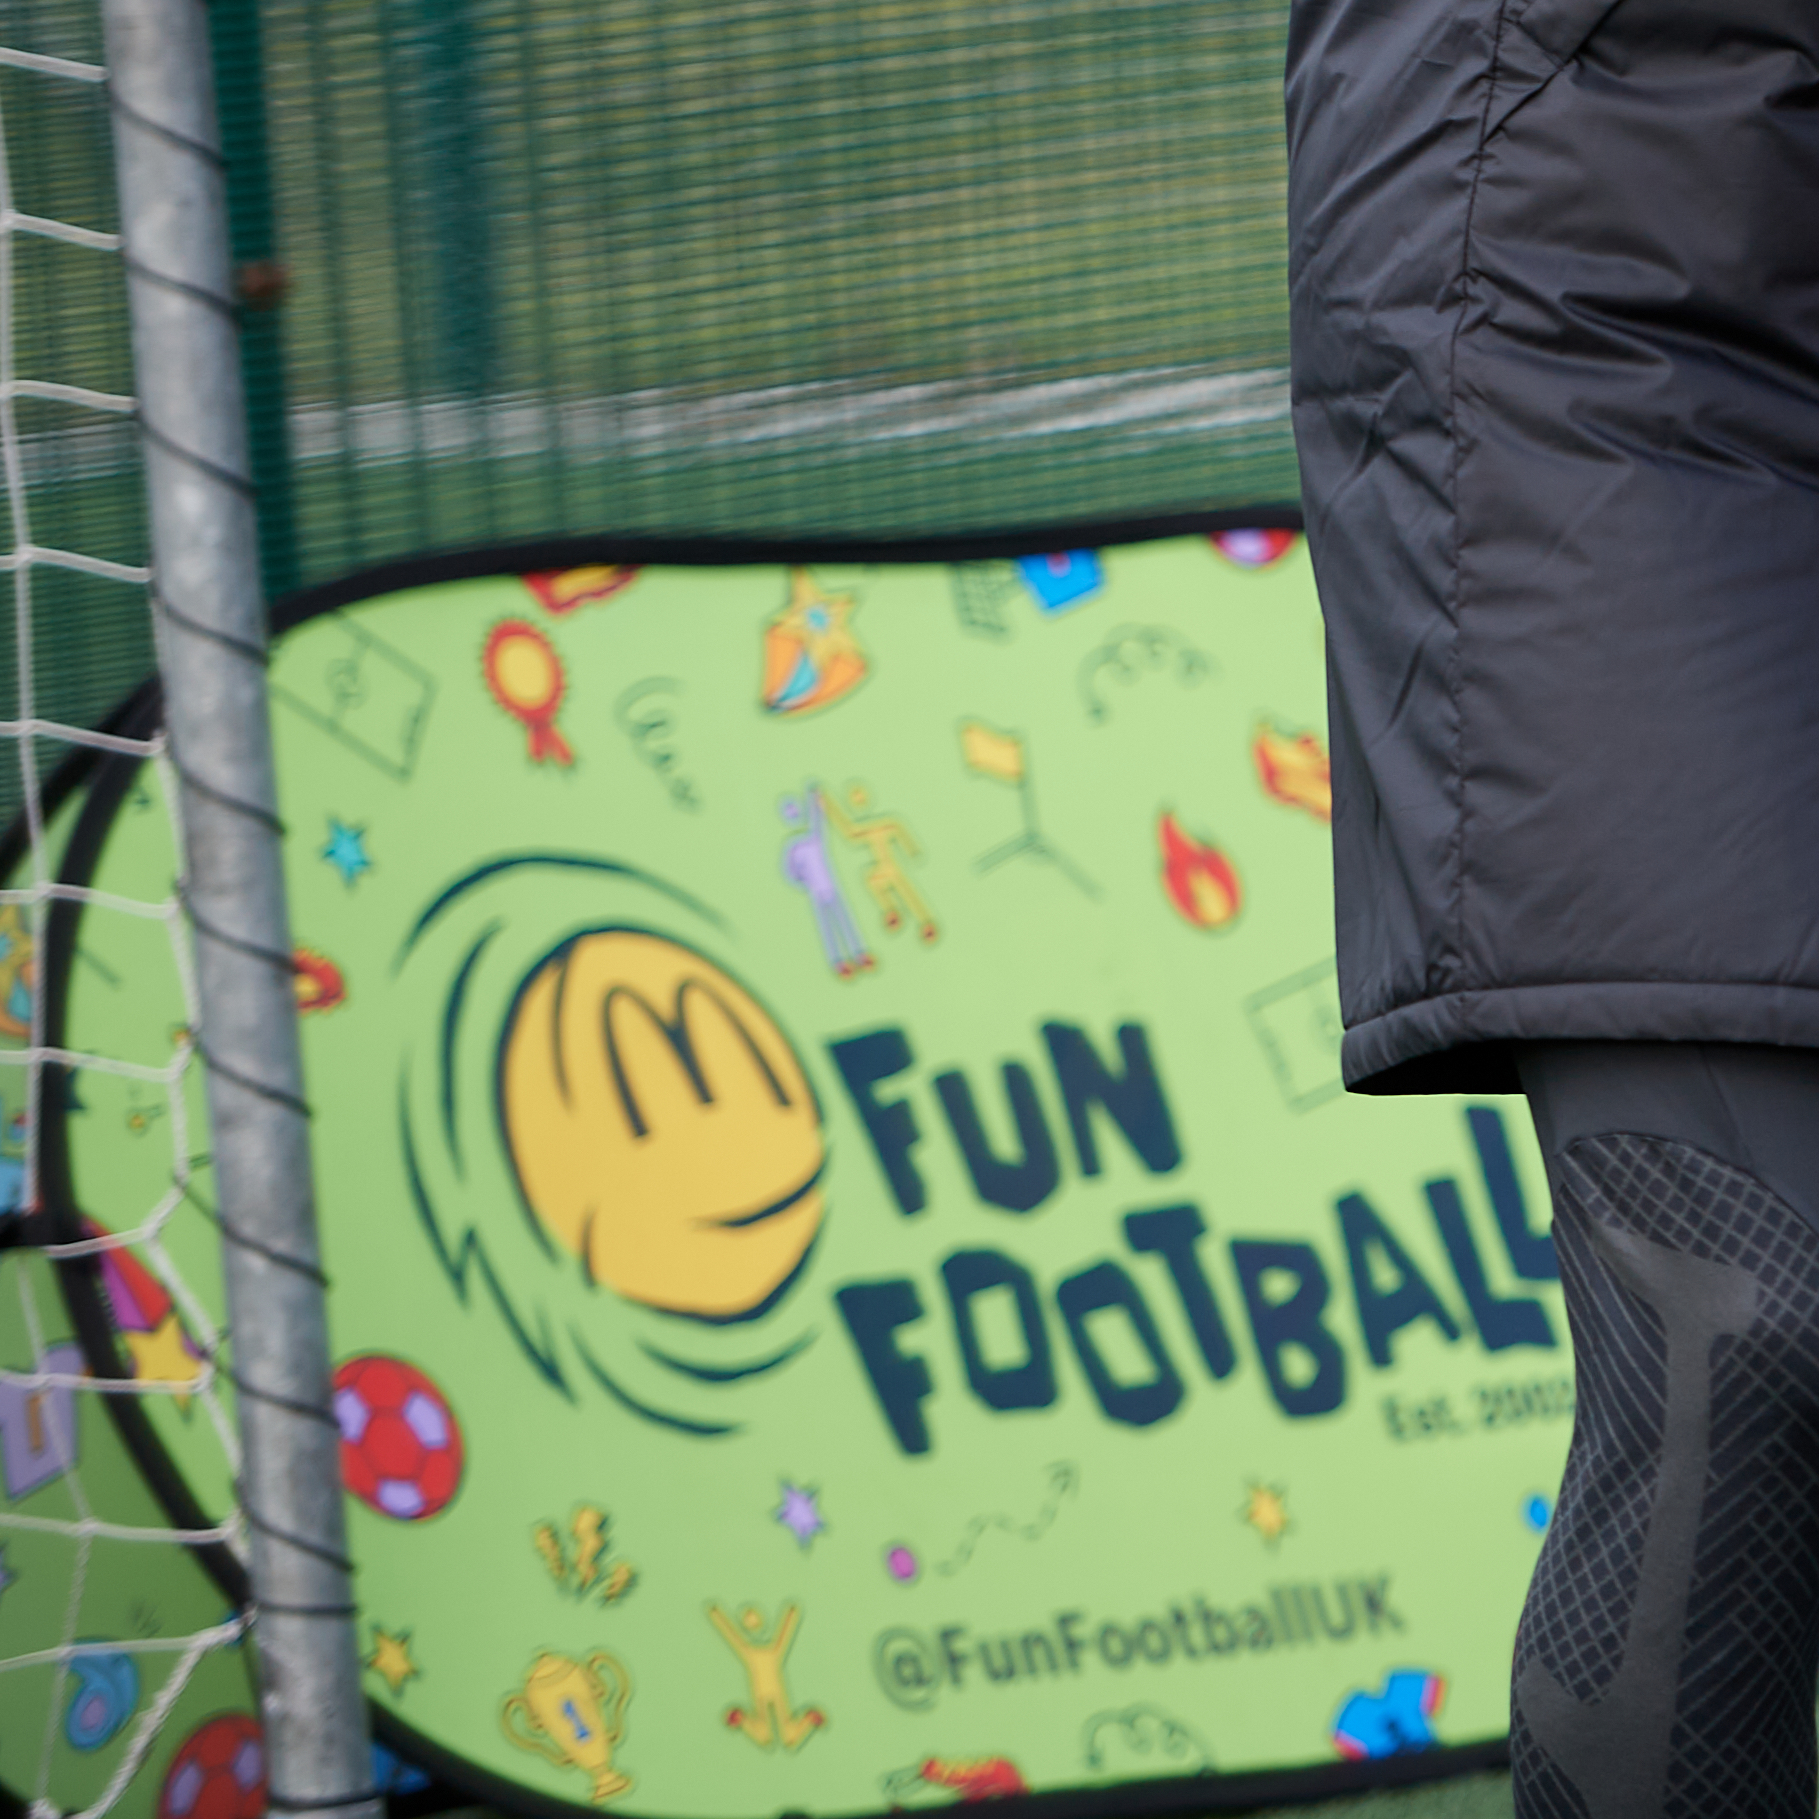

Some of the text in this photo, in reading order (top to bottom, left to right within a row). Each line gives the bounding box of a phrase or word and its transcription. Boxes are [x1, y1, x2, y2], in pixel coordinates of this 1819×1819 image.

[825, 1019, 1184, 1218] FUN
[832, 1105, 1563, 1458] FOOTBALL
[1382, 1392, 1463, 1443] Est.
[871, 1573, 1408, 1713] @FunFootballUK
